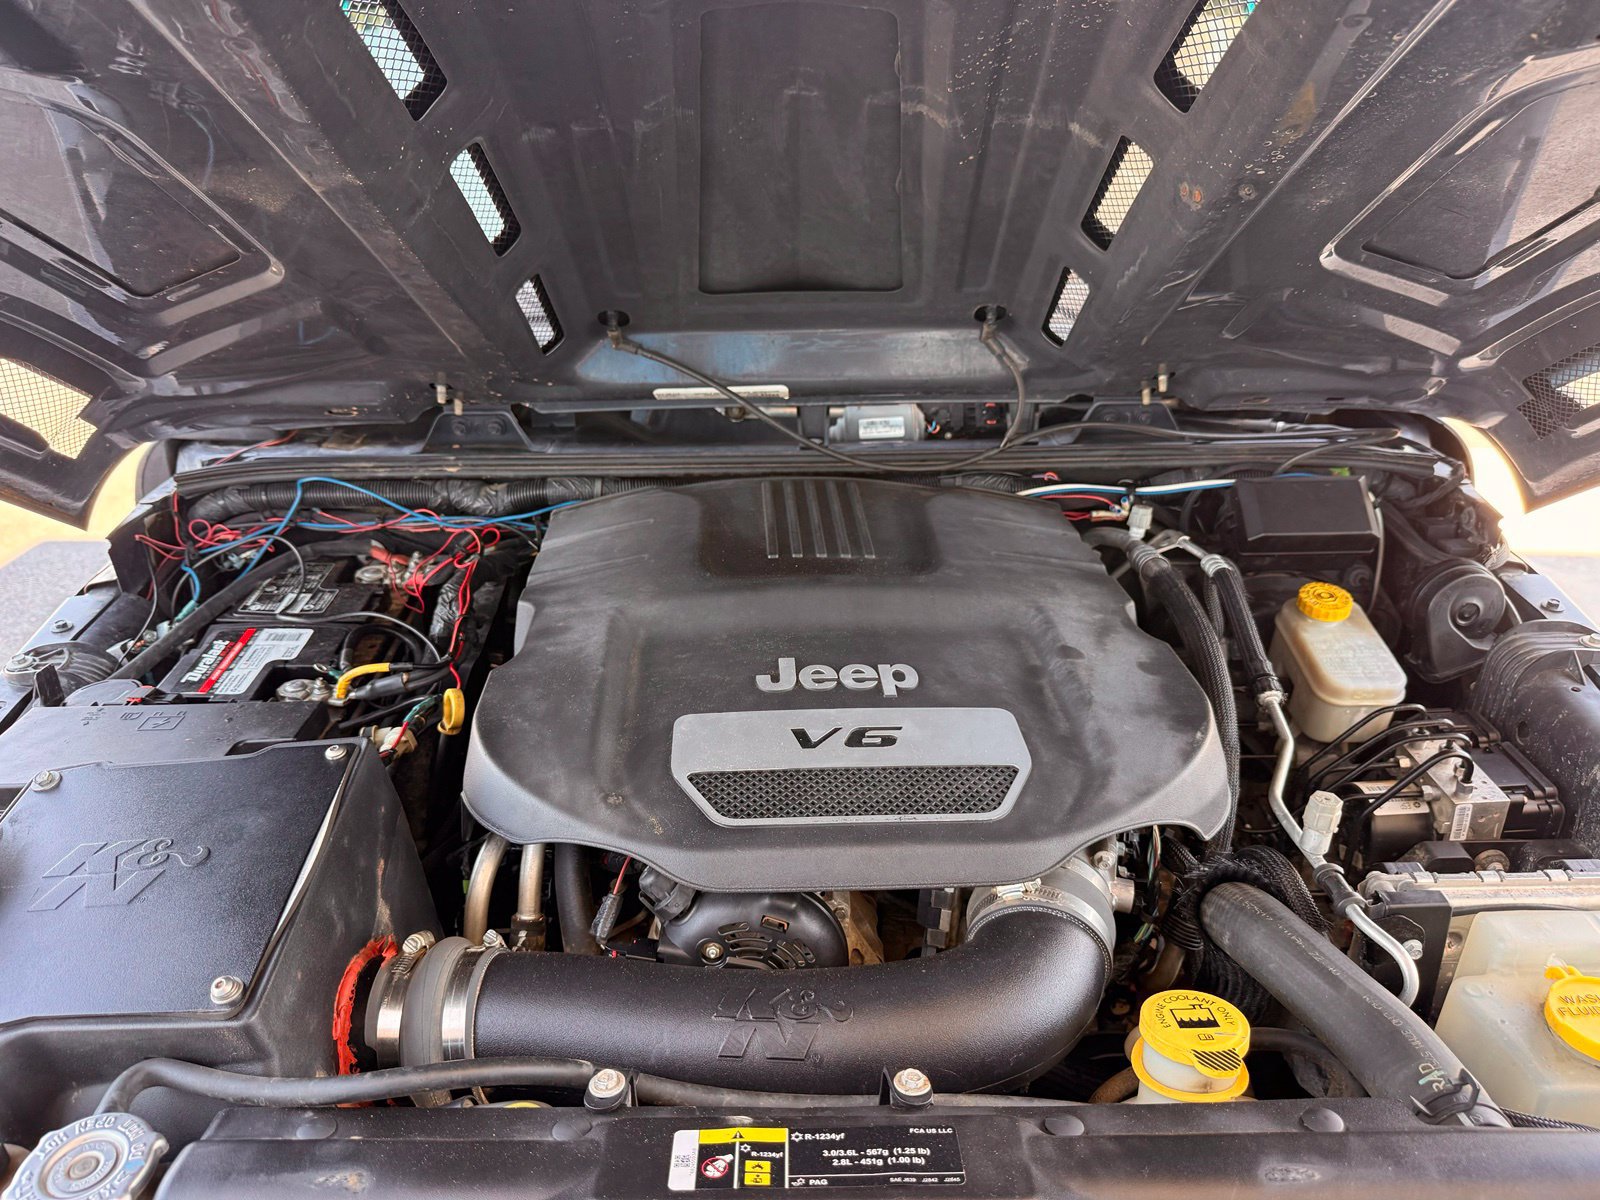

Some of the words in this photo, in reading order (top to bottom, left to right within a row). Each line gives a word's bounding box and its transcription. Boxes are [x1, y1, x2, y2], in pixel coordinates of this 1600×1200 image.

[180, 639, 231, 683] Duralast
[755, 657, 919, 698] Jeep
[790, 726, 903, 749] V6
[1163, 994, 1216, 1007] COOLANT
[1155, 1002, 1172, 1029] ENGINE
[1216, 1006, 1236, 1027] ONLY
[74, 1115, 116, 1135] OPEN
[909, 1127, 925, 1135] FCA
[804, 1132, 846, 1142] R-1234yf
[750, 1151, 784, 1159] R-1234yf
[822, 1148, 859, 1157] 3.0/3.6L
[866, 1147, 889, 1156] 567g
[893, 1146, 915, 1155] (1.25
[917, 1146, 931, 1155] lb)
[832, 1158, 853, 1166] 2.8L
[859, 1157, 884, 1166] 451g
[887, 1156, 910, 1165] (1.00
[912, 1156, 926, 1165] lb)
[809, 1178, 829, 1186] PAG
